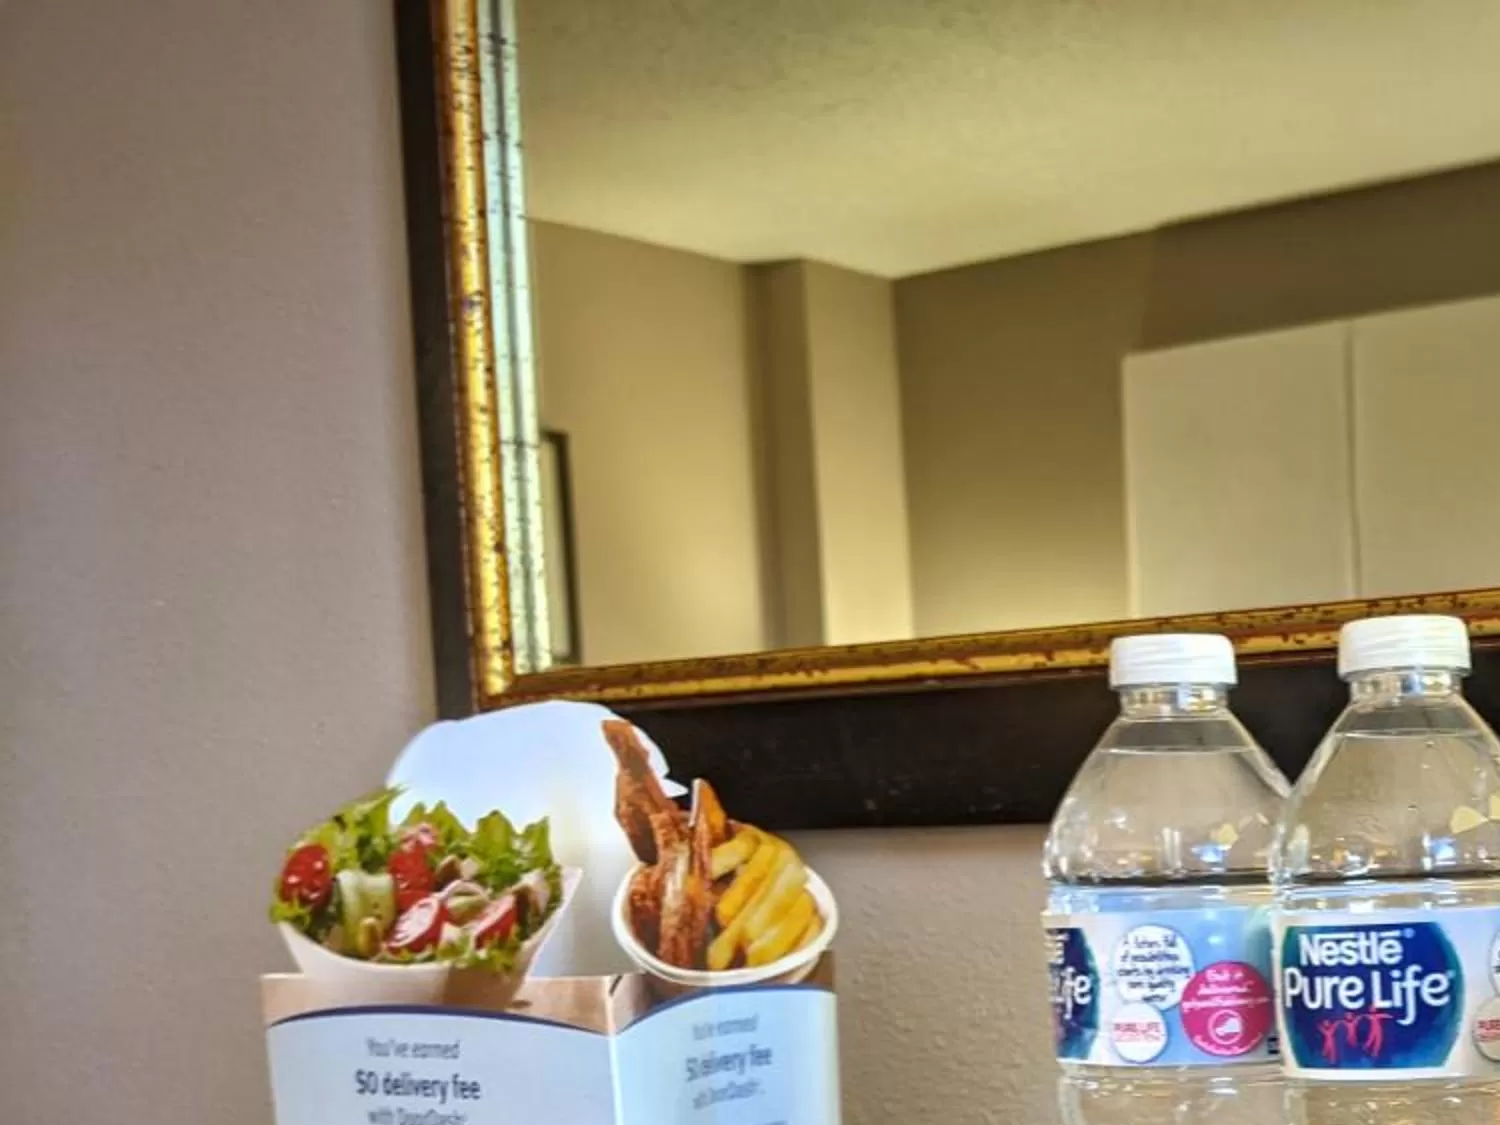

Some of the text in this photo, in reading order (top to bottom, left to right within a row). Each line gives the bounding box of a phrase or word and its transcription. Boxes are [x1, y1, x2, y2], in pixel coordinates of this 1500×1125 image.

[1284, 964, 1451, 1026] Pure Life
[382, 1071, 449, 1104] delivery
[451, 1072, 481, 1101] fee
